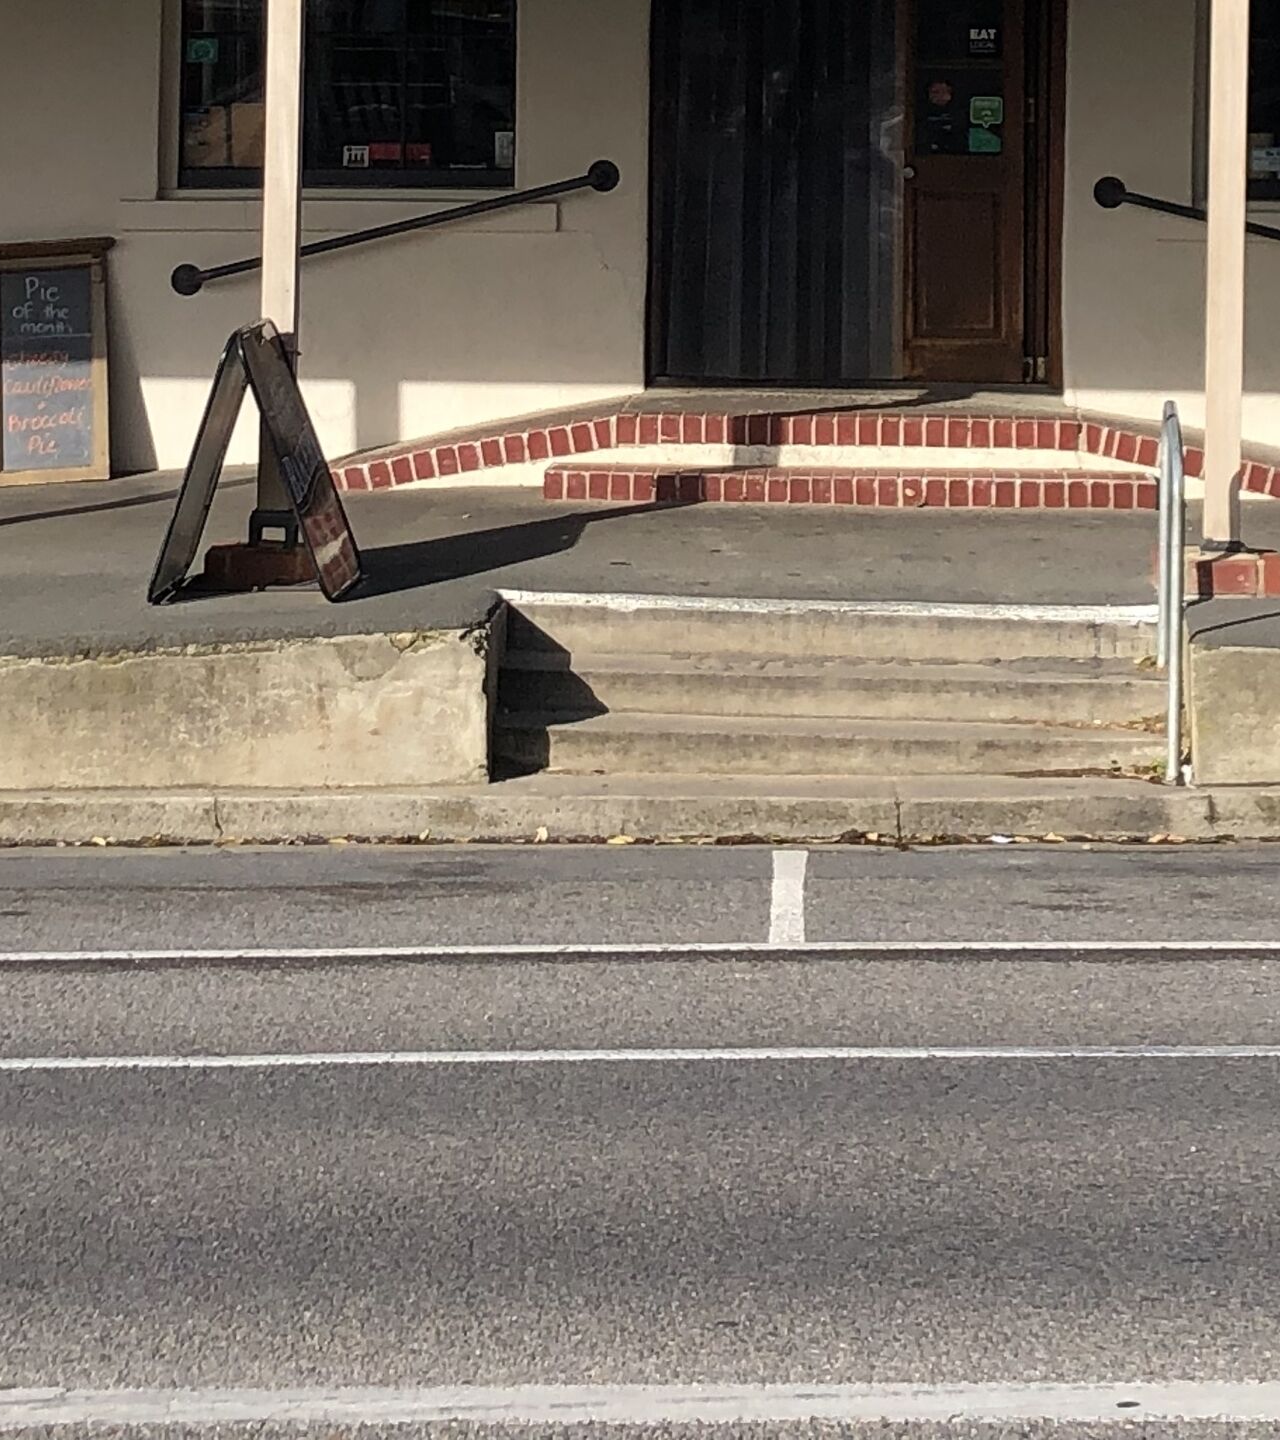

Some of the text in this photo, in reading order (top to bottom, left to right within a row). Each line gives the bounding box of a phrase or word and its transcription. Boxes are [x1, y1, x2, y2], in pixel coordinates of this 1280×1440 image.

[969, 28, 997, 40] EAT
[24, 276, 61, 302] Pie
[12, 301, 70, 320] of the
